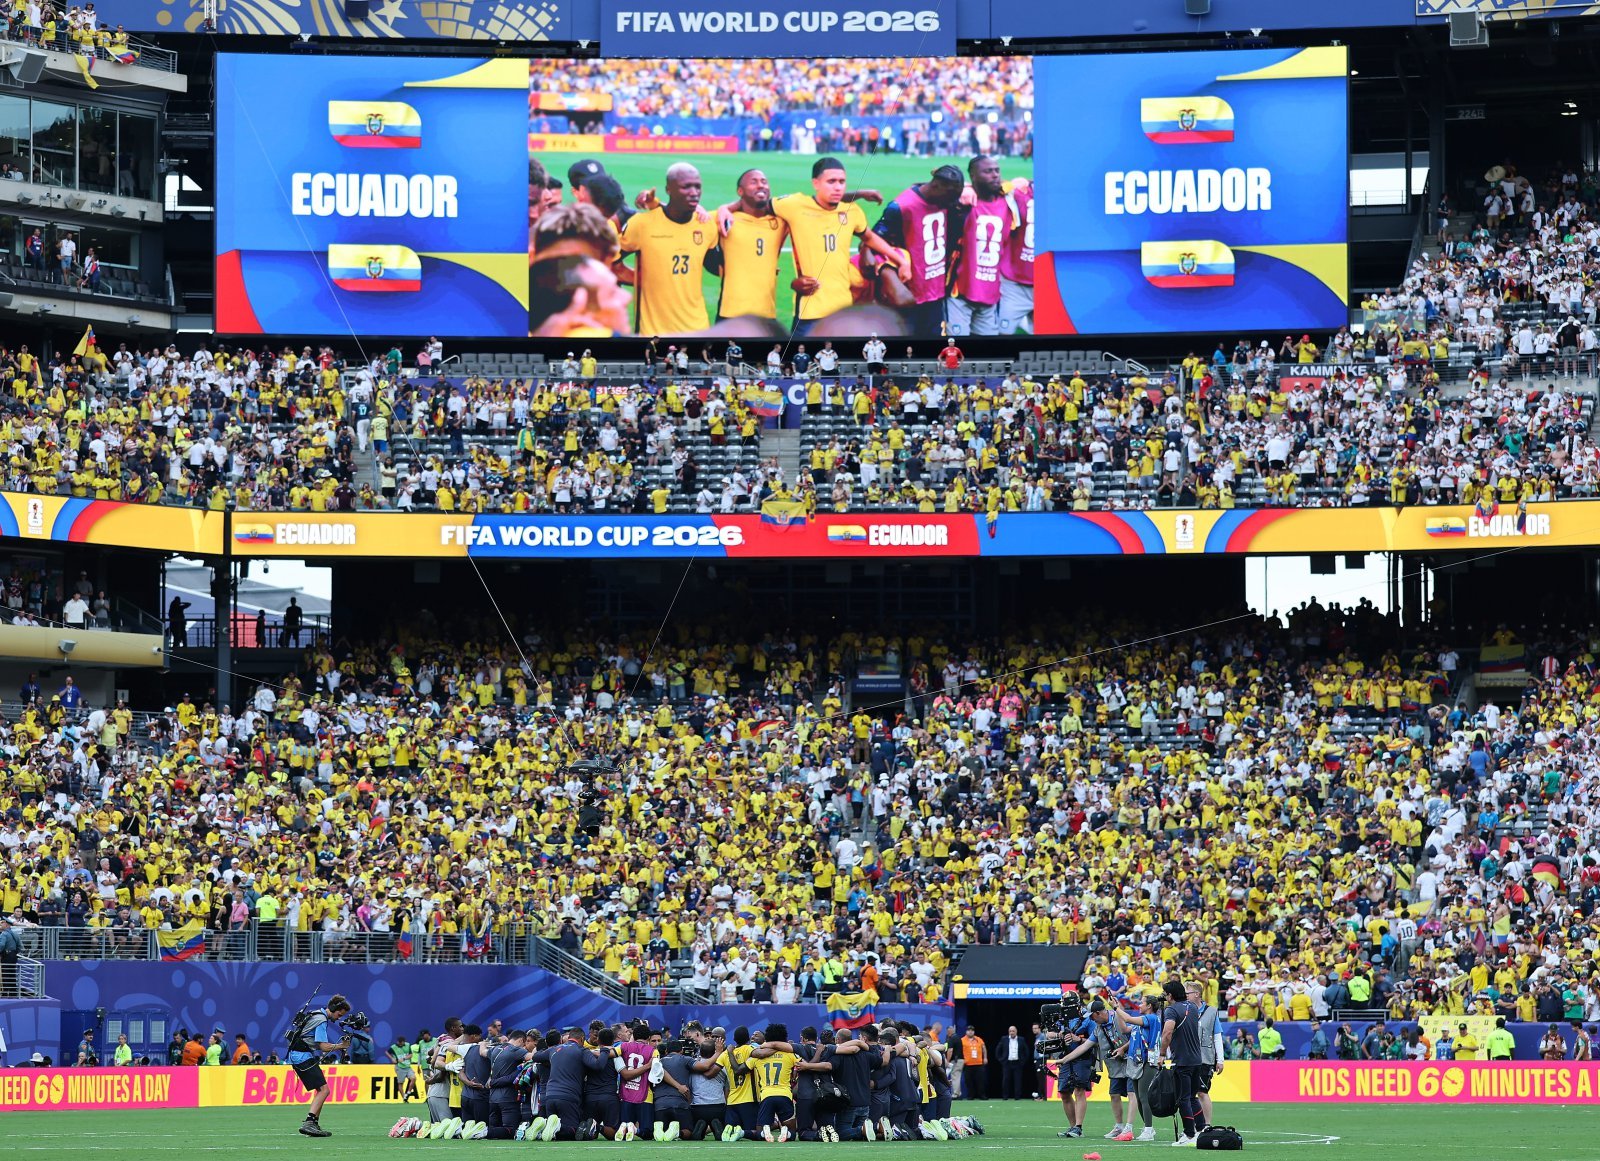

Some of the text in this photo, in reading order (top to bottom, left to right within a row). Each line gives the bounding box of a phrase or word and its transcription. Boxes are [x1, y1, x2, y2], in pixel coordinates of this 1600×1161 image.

[617, 10, 939, 33] FIFA WORLD CUP 2026
[291, 172, 458, 218] ECUADOR
[1104, 167, 1272, 215] ECUADOR
[756, 238, 764, 256] 9
[823, 234, 836, 252] 10
[672, 254, 690, 275] 23
[276, 523, 356, 545] ECUADOR
[441, 525, 743, 547] FIFA WORLD CUP 2026
[869, 524, 948, 546] ECUADOR
[1402, 926, 1413, 938] 10
[967, 987, 1061, 995] FIFA WORLD CUP 2026
[764, 1062, 783, 1086] 17
[1299, 1067, 1350, 1097] KIDS
[1356, 1068, 1411, 1097] NEED
[1417, 1066, 1465, 1097] 60
[1471, 1068, 1572, 1097] MINUTES
[1576, 1068, 1592, 1097] A
[34, 1074, 65, 1105] 60
[68, 1074, 130, 1104] MINUTES
[133, 1075, 142, 1102] A
[145, 1074, 171, 1102] DAY
[242, 1068, 279, 1104] Be
